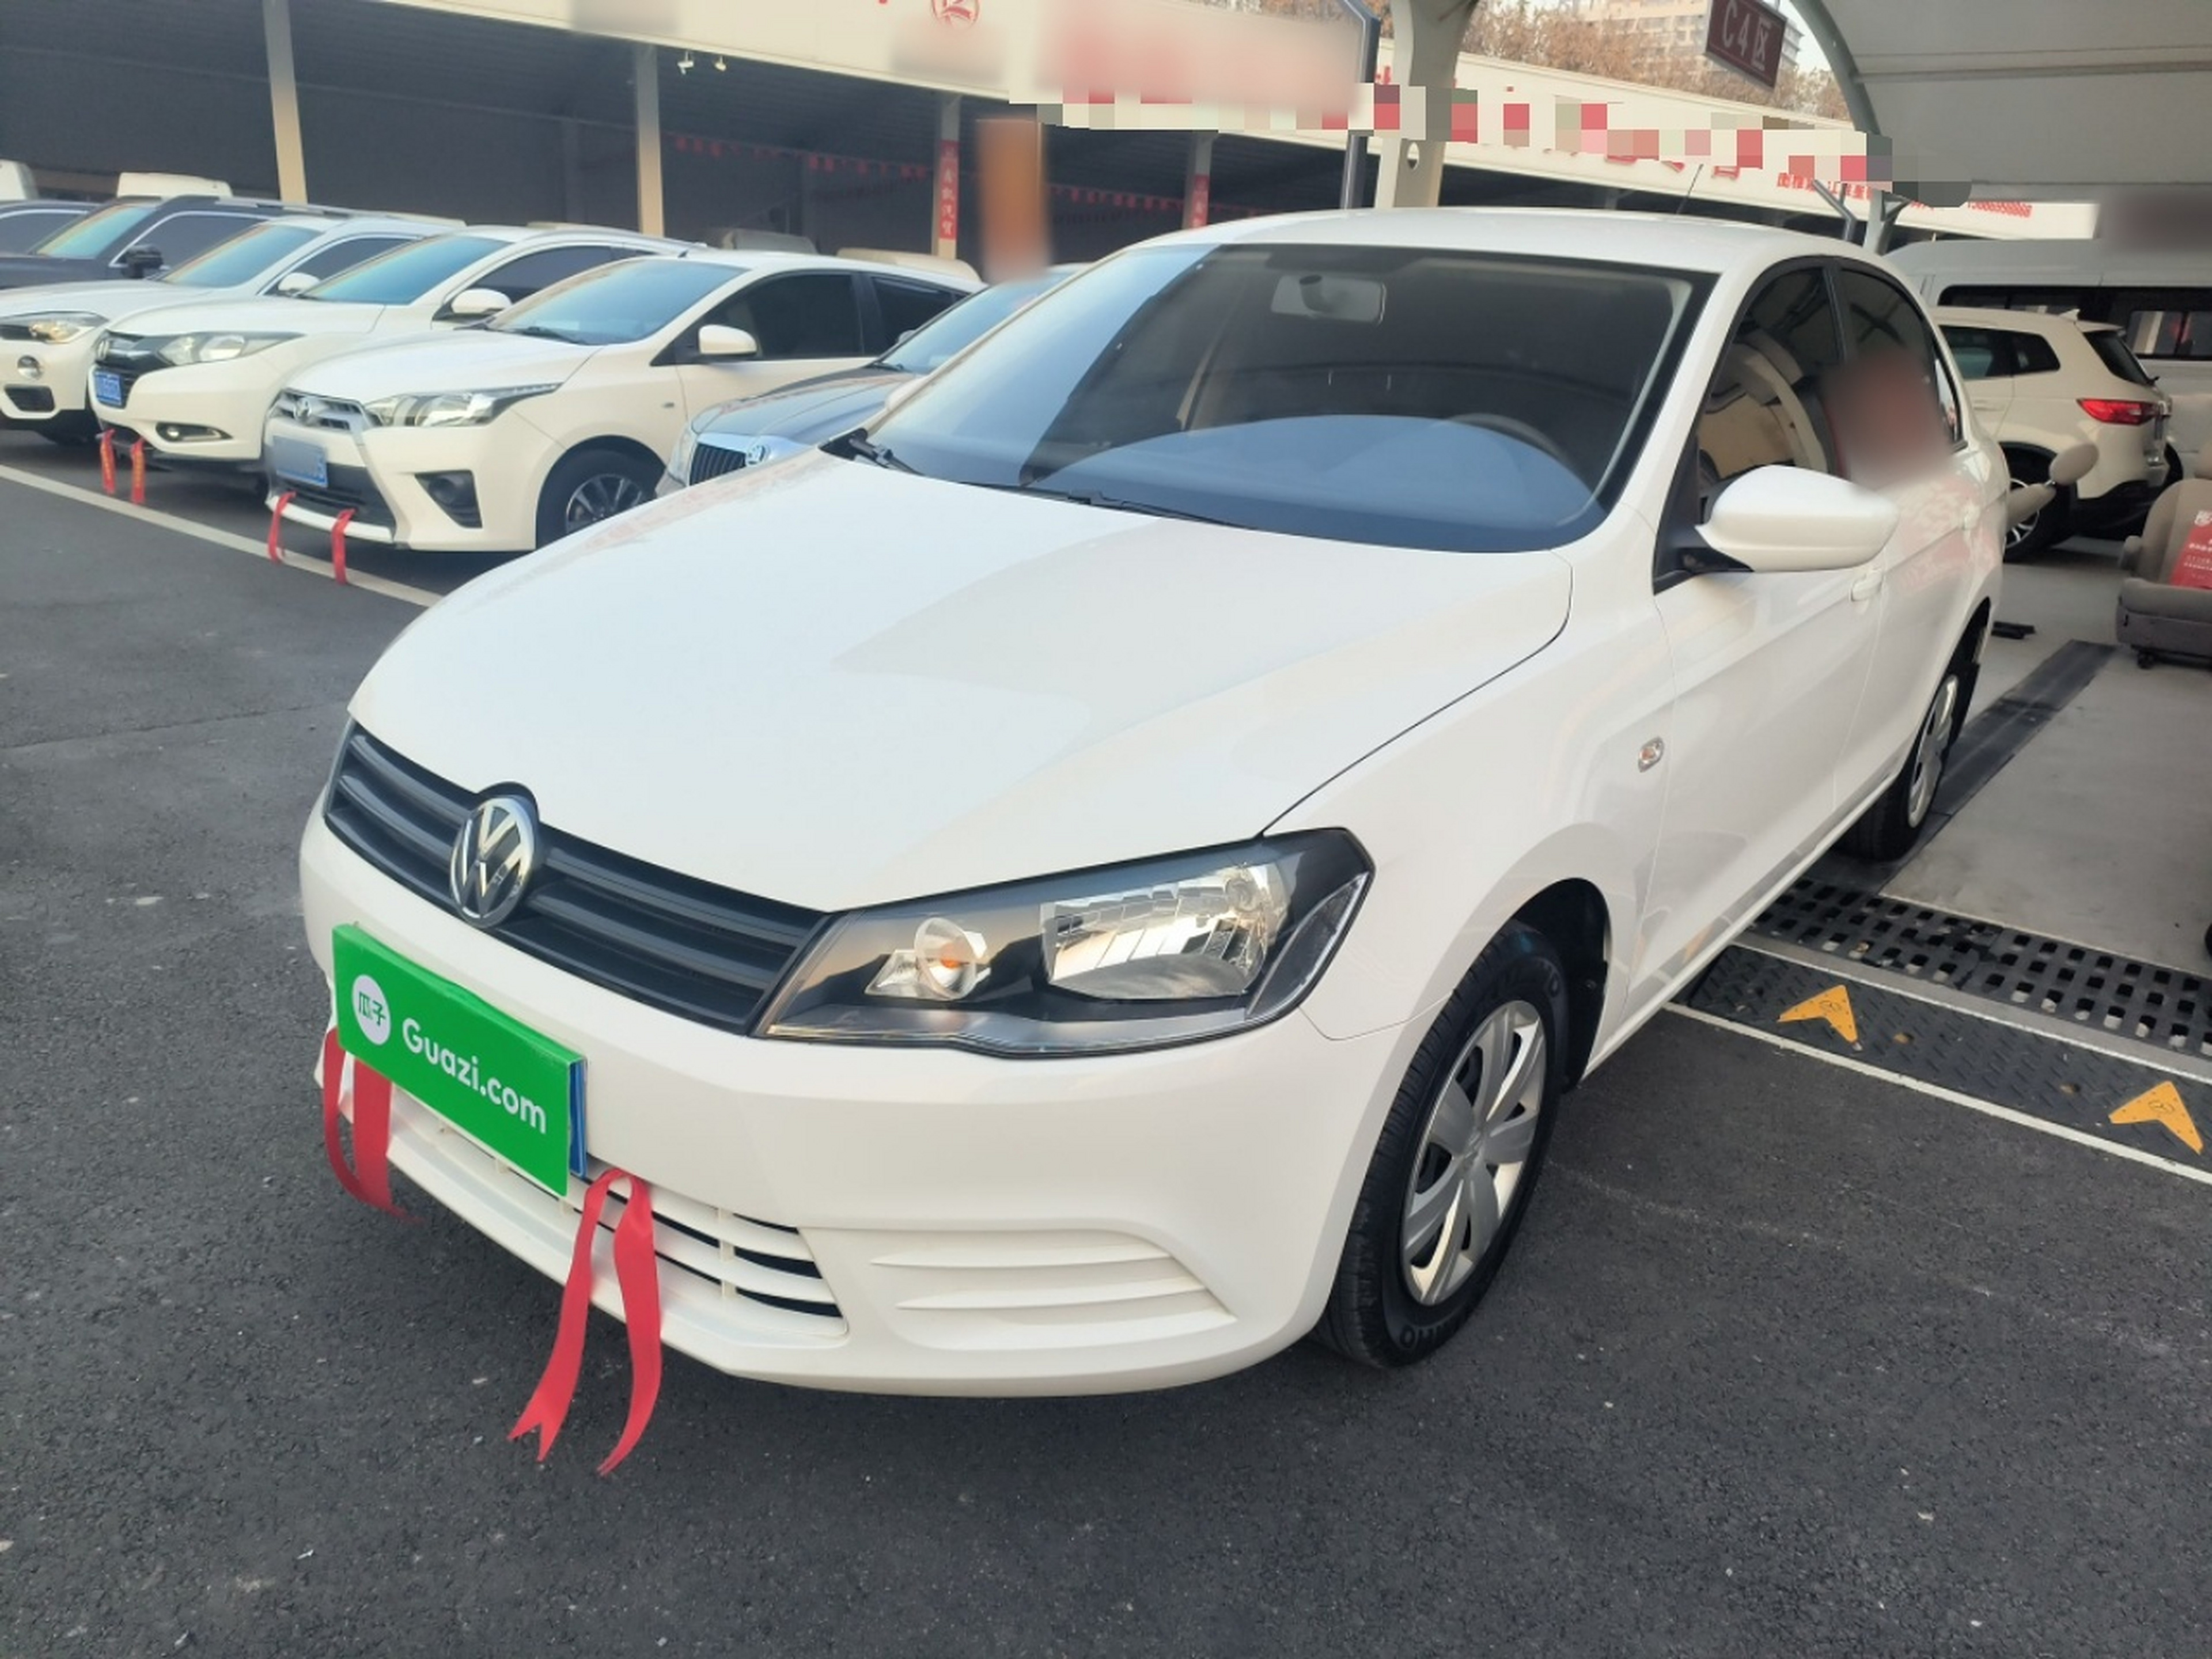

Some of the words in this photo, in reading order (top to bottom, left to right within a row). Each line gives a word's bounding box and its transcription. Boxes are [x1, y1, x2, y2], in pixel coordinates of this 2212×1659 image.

[1722, 0, 1772, 71] C4区
[358, 991, 387, 1027] 瓜子
[402, 1017, 546, 1135] Guazi.com
